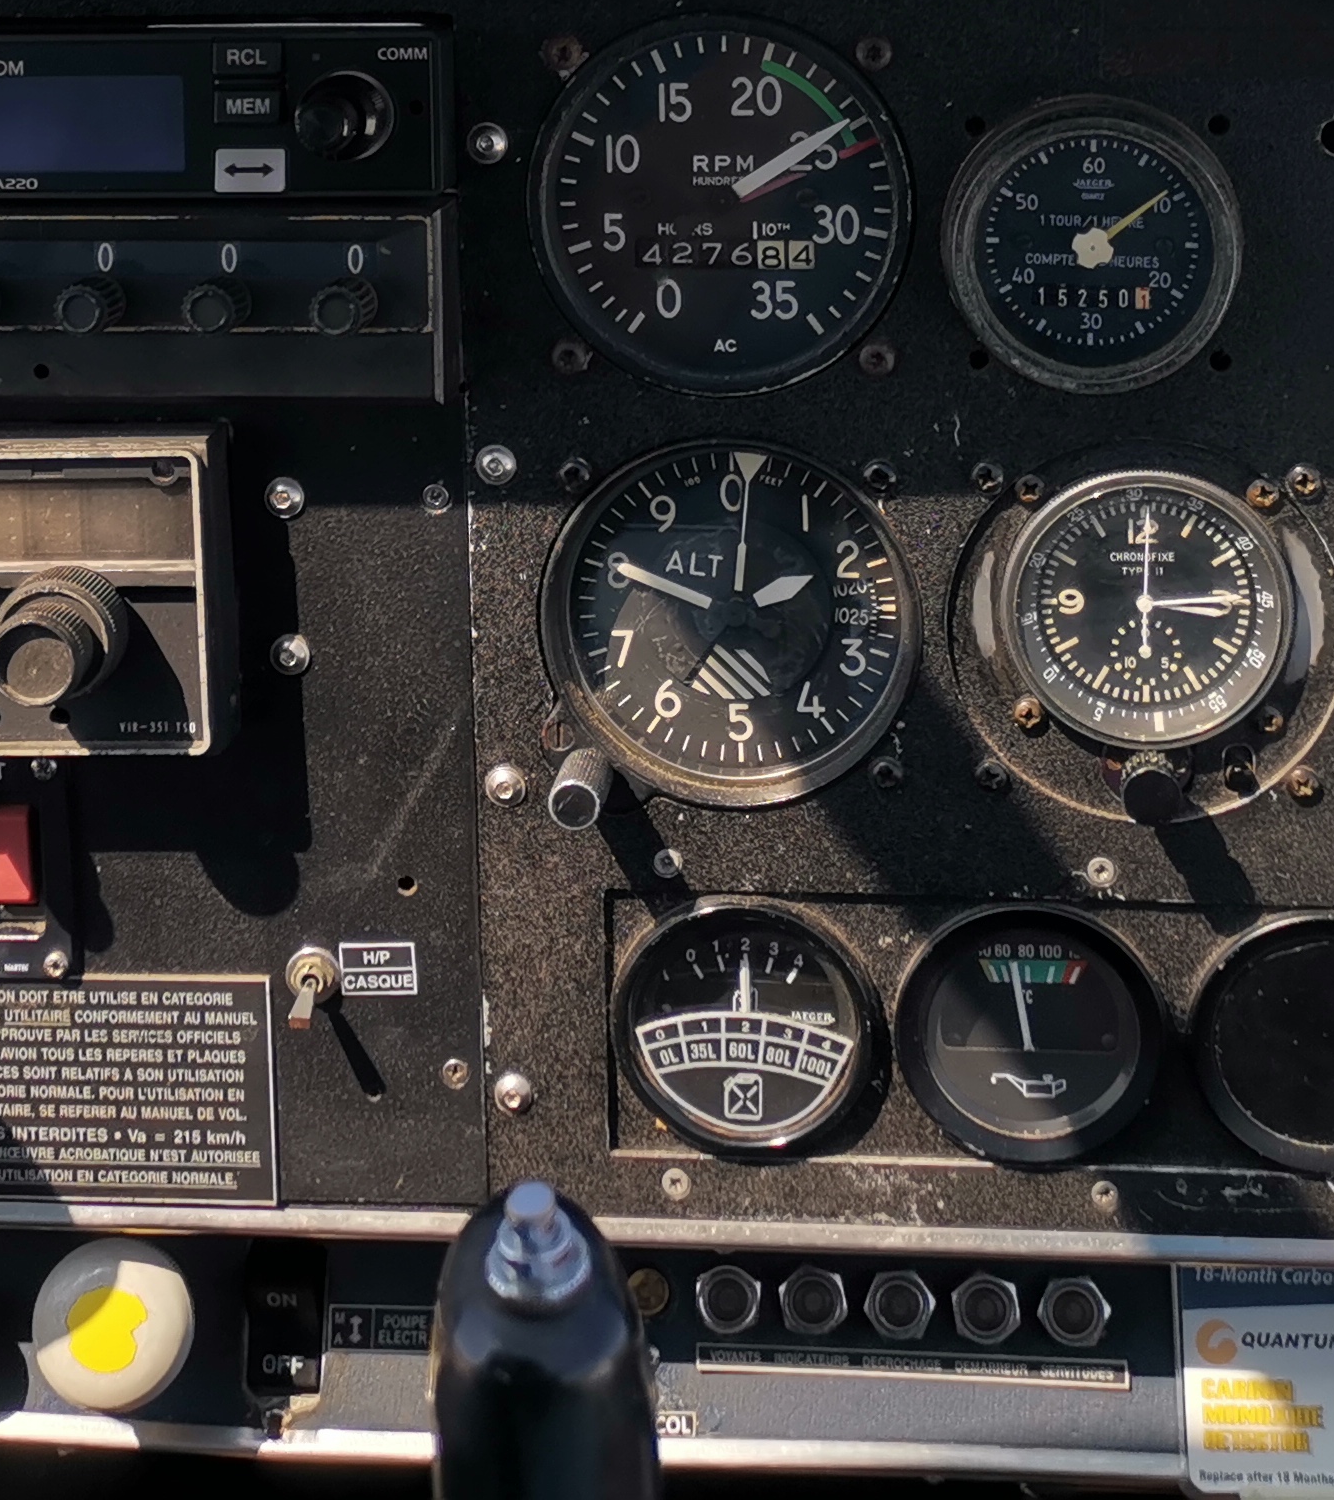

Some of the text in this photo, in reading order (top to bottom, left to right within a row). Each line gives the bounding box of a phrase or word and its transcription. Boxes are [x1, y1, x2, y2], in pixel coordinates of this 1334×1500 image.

[377, 47, 428, 61] COMM
[658, 82, 692, 123] 15
[730, 76, 783, 117] 20
[605, 134, 640, 174] 10
[1082, 157, 1106, 175] 60
[1015, 193, 1039, 211] 50
[1154, 197, 1172, 214] 10
[812, 204, 860, 245] 30
[1012, 268, 1035, 285] 40
[1149, 271, 1172, 289] 20
[750, 280, 799, 320] 35
[1080, 313, 1103, 330] 30
[1126, 487, 1143, 500] 30
[649, 495, 676, 532] 9
[1127, 518, 1159, 545] 12
[665, 550, 724, 578] ALT
[1109, 552, 1175, 563] CHRONOFIXE
[1058, 588, 1085, 614] 9
[1256, 590, 1274, 609] 45
[611, 630, 634, 668] 7
[839, 638, 866, 676] 3
[1123, 657, 1137, 669] 10
[1160, 657, 1169, 669] 5
[654, 680, 681, 718] 6
[796, 681, 825, 718] 4
[1208, 690, 1228, 714] 55
[728, 703, 754, 741] 5
[362, 951, 390, 964] H/P
[768, 942, 779, 955] 3
[1017, 944, 1062, 958] 80 100
[344, 974, 413, 990] CASQUE
[19, 990, 49, 1003] DOIT
[53, 991, 85, 1004] ETRE
[89, 991, 137, 1004] UTILISE
[141, 992, 158, 1005] EN
[162, 992, 233, 1006] CATEGORIE
[4, 1008, 71, 1021] UTILITAIRE
[75, 1009, 179, 1024] CONFORMEMENT
[184, 1012, 201, 1024] AU
[205, 1012, 258, 1025] MANUEL
[790, 1010, 836, 1024] JAEGER
[56, 1029, 81, 1042] PAR
[84, 1029, 108, 1042] LES
[112, 1030, 173, 1043] SERVICES
[177, 1031, 241, 1044] OFFICIELS
[187, 1050, 246, 1064] PLAQUES
[659, 1042, 834, 1078] 0L 35L 60L 80L 100L
[141, 1106, 193, 1120] MANUEL
[12, 1127, 108, 1142] INTERDITES
[207, 1130, 246, 1146] km/h
[1194, 1266, 1275, 1285] 18-Month
[267, 1292, 297, 1308] ON
[382, 1314, 429, 1329] POMPE
[262, 1354, 305, 1375] OFF
[710, 1350, 1115, 1381] VOYANTS INDICATEURS DECROCHAGE DEMARREUR SERVITUDES
[1199, 1469, 1334, 1484] Replace Months
